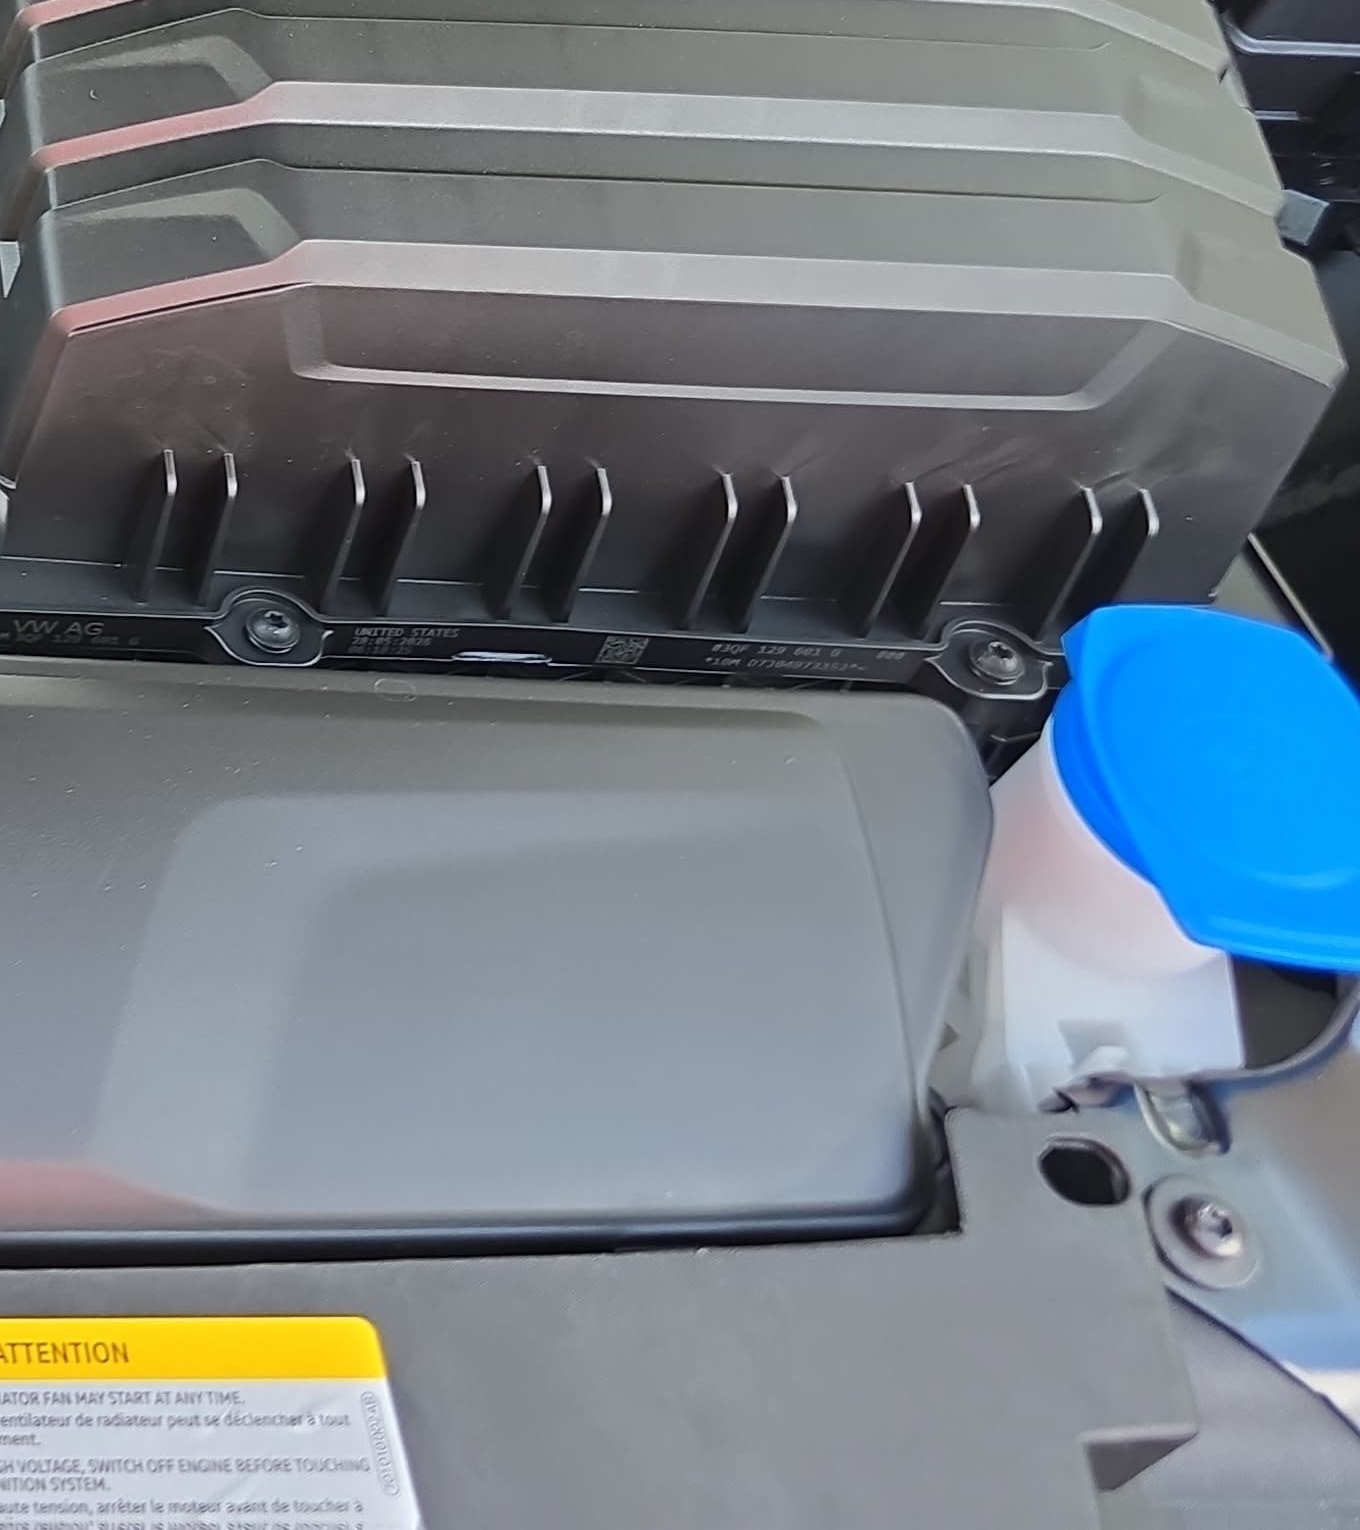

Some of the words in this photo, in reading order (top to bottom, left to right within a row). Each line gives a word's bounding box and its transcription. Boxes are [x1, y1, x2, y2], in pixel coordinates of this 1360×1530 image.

[13, 620, 59, 634] VW
[63, 622, 106, 636] AG
[354, 627, 404, 637] UNITED
[411, 627, 462, 638] STATES
[44, 1391, 73, 1407] FAN
[79, 1391, 105, 1407] MAY
[108, 1391, 151, 1407] START
[153, 1391, 172, 1407] AT
[175, 1391, 204, 1407] ANY
[205, 1390, 246, 1406] TIME.
[74, 1412, 94, 1428] de
[97, 1412, 165, 1428] radiateur
[167, 1413, 201, 1431] peut
[202, 1414, 221, 1428] se
[223, 1410, 305, 1428] déclencher
[306, 1411, 318, 1427] à
[319, 1412, 351, 1428] tout
[20, 1458, 86, 1476] VOLTAGE,
[87, 1458, 144, 1474] SWITCH
[146, 1458, 176, 1474] OFF
[178, 1457, 235, 1473] ENGINE
[236, 1458, 292, 1474] BEFORE
[293, 1458, 372, 1474] TOUCHING
[50, 1476, 112, 1493] SYSTEM.
[32, 1498, 94, 1517] tension,
[96, 1497, 146, 1515] arrêter
[148, 1498, 164, 1515] le
[166, 1500, 222, 1515] moteur
[224, 1500, 263, 1515] avant
[264, 1498, 289, 1514] de
[292, 1498, 351, 1514] toucher
[351, 1498, 364, 1514] à
